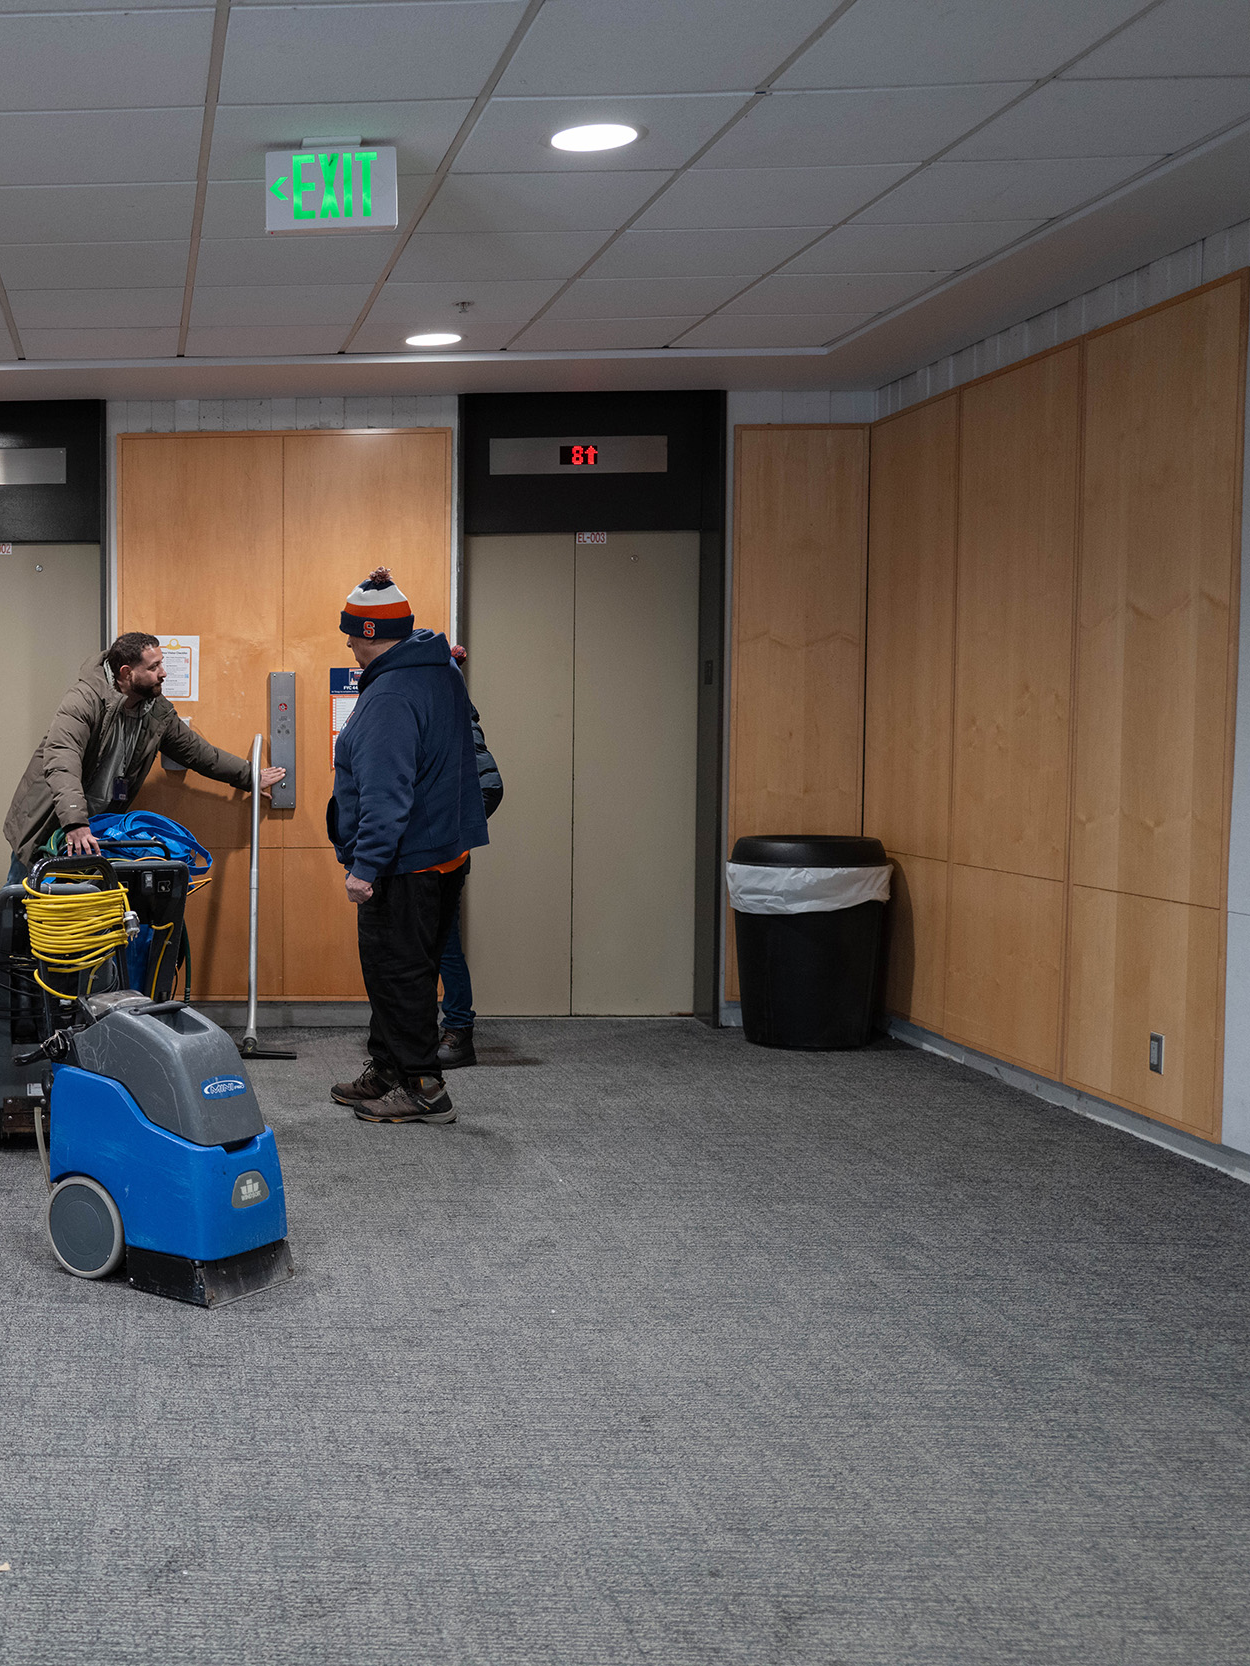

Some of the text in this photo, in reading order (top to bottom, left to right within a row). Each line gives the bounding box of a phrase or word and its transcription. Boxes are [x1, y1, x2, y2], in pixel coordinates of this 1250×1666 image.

[292, 152, 378, 220] EXIT
[571, 445, 584, 465] 8
[577, 533, 606, 543] EL-003
[363, 621, 376, 637] S
[210, 1083, 234, 1095] MINI
